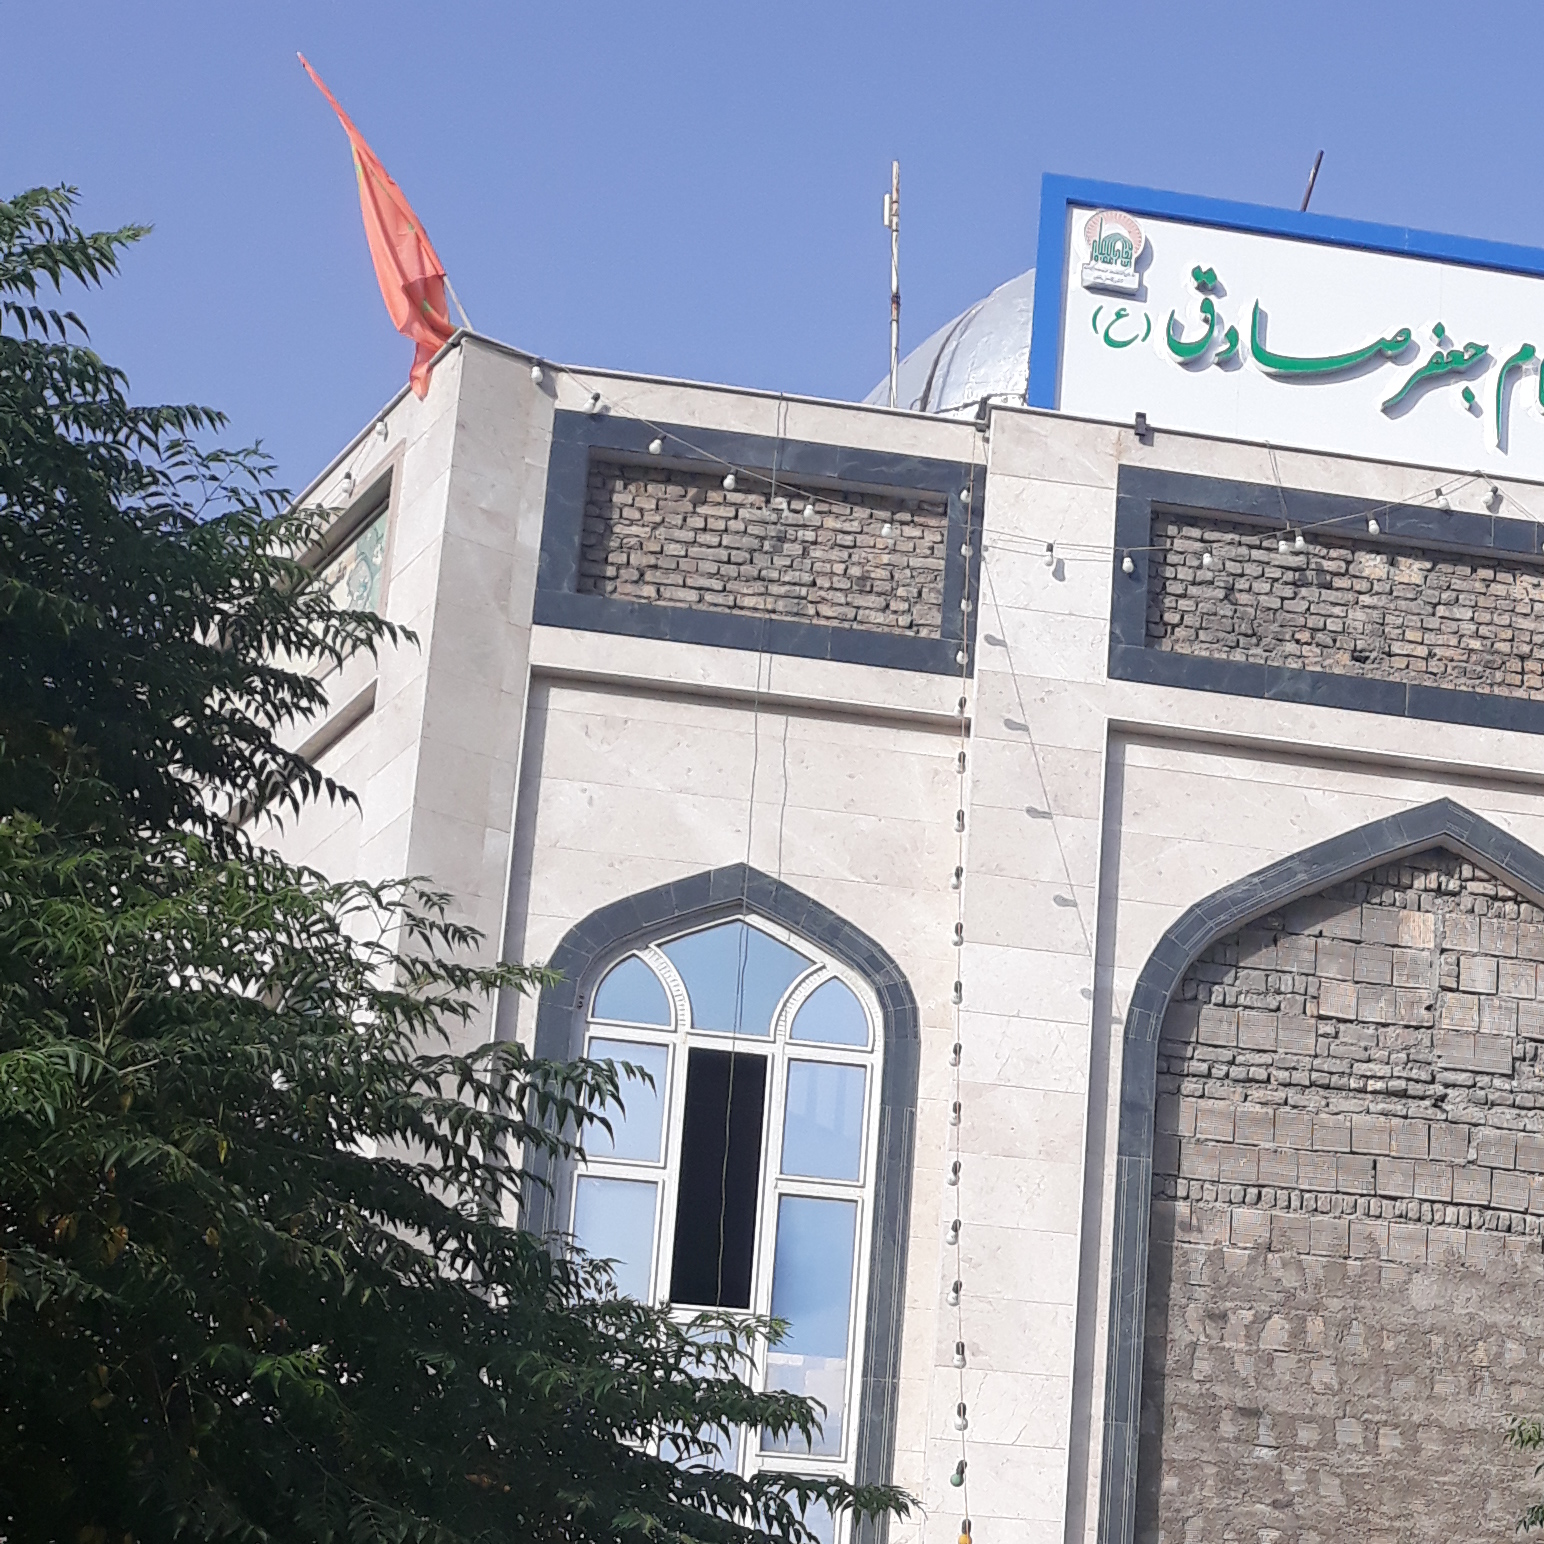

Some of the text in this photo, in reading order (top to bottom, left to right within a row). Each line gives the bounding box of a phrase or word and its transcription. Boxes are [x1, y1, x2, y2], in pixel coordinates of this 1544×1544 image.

[1092, 304, 1152, 350] (ع)
[1166, 265, 1411, 374] صادق
[1381, 322, 1489, 411] جعفر
